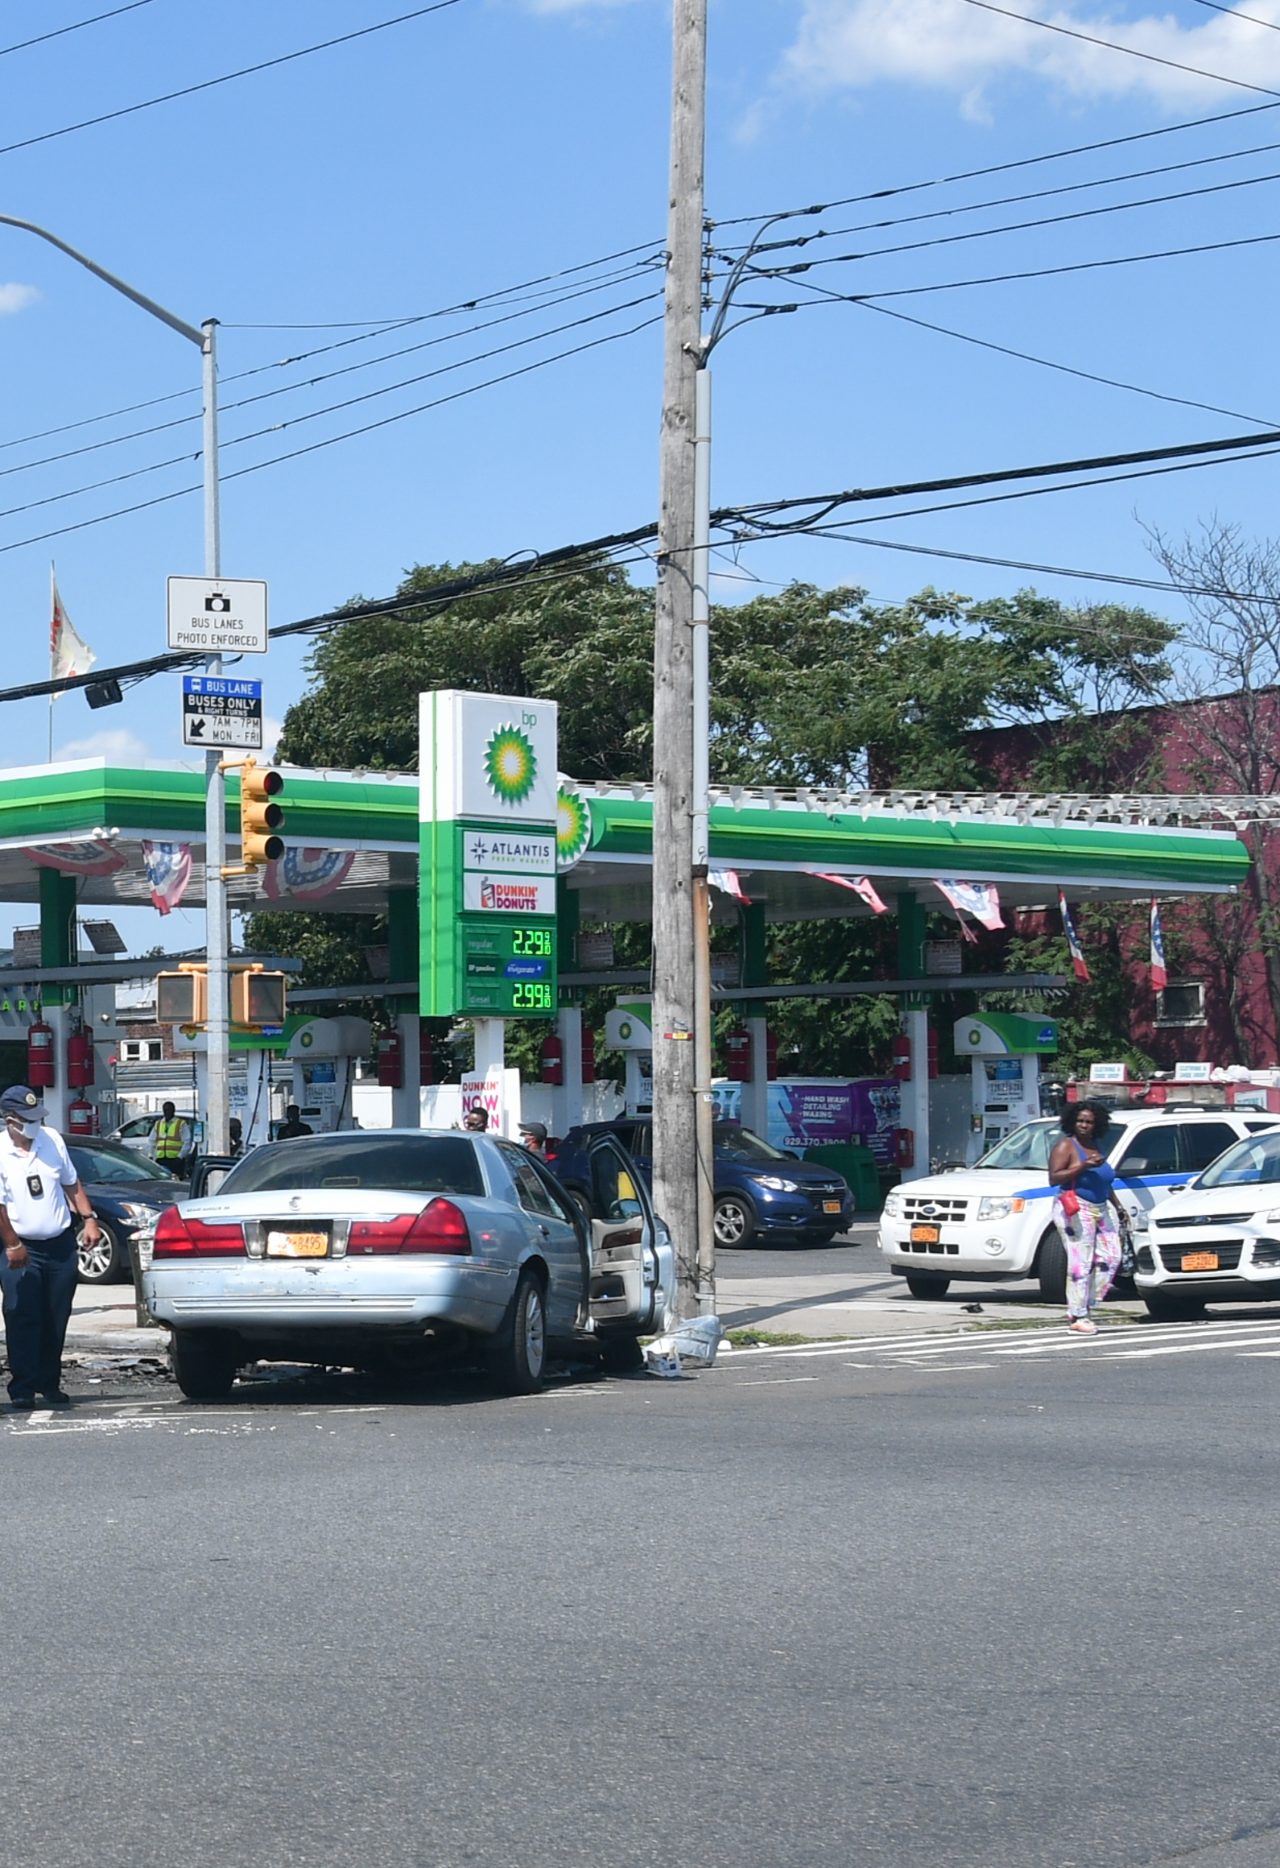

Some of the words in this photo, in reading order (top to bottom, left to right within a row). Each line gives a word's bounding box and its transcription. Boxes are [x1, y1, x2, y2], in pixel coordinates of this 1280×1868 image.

[191, 617, 210, 629] BUS
[214, 619, 244, 630] LANES
[177, 632, 207, 644] PHOTO
[211, 634, 258, 647] ENFORCED
[207, 681, 226, 693] BUS
[228, 683, 254, 695] LANE
[188, 695, 225, 708] BUSES
[227, 698, 257, 710] ONLY
[205, 707, 224, 715] RIGHT
[226, 709, 248, 717] TURNS
[213, 715, 231, 727] 7AM
[241, 717, 259, 729] 7PM
[522, 710, 537, 729] bp
[212, 730, 232, 741] MON
[244, 732, 260, 743] FRI
[491, 842, 550, 858] ATLANTIS
[496, 884, 538, 898] DUNKIN'
[496, 897, 537, 911] DONUTS
[463, 1095, 498, 1112] NOW
